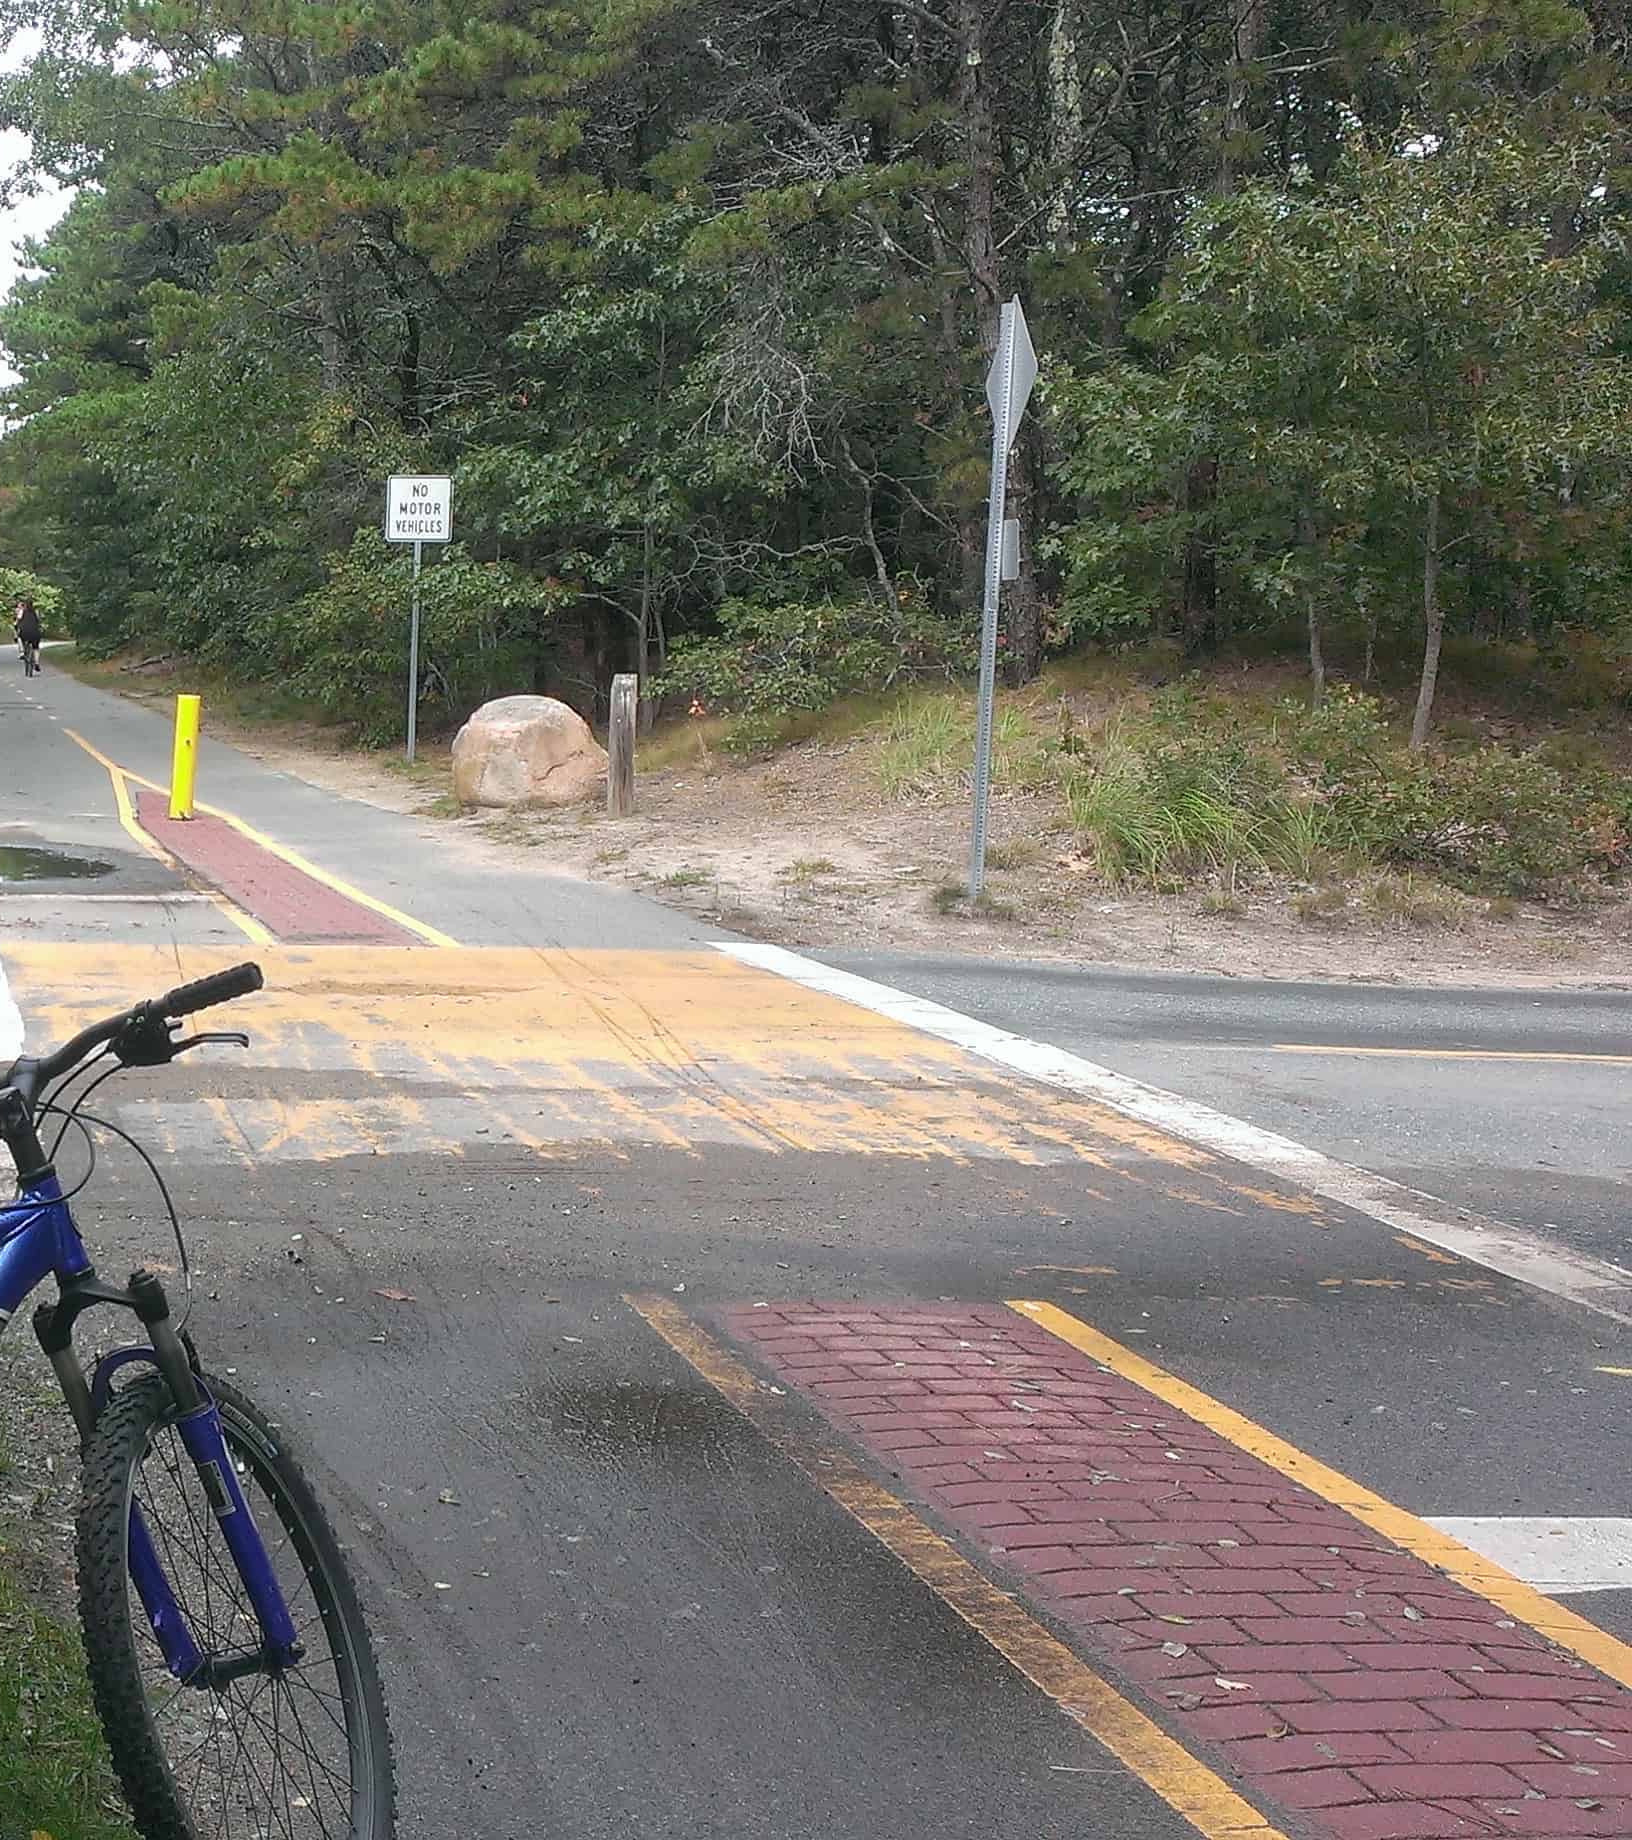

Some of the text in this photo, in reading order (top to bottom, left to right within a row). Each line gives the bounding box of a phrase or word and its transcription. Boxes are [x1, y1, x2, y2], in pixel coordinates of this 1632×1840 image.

[412, 485, 428, 497] NO
[399, 503, 441, 515] MOTOR
[396, 520, 442, 533] VEHICLES
